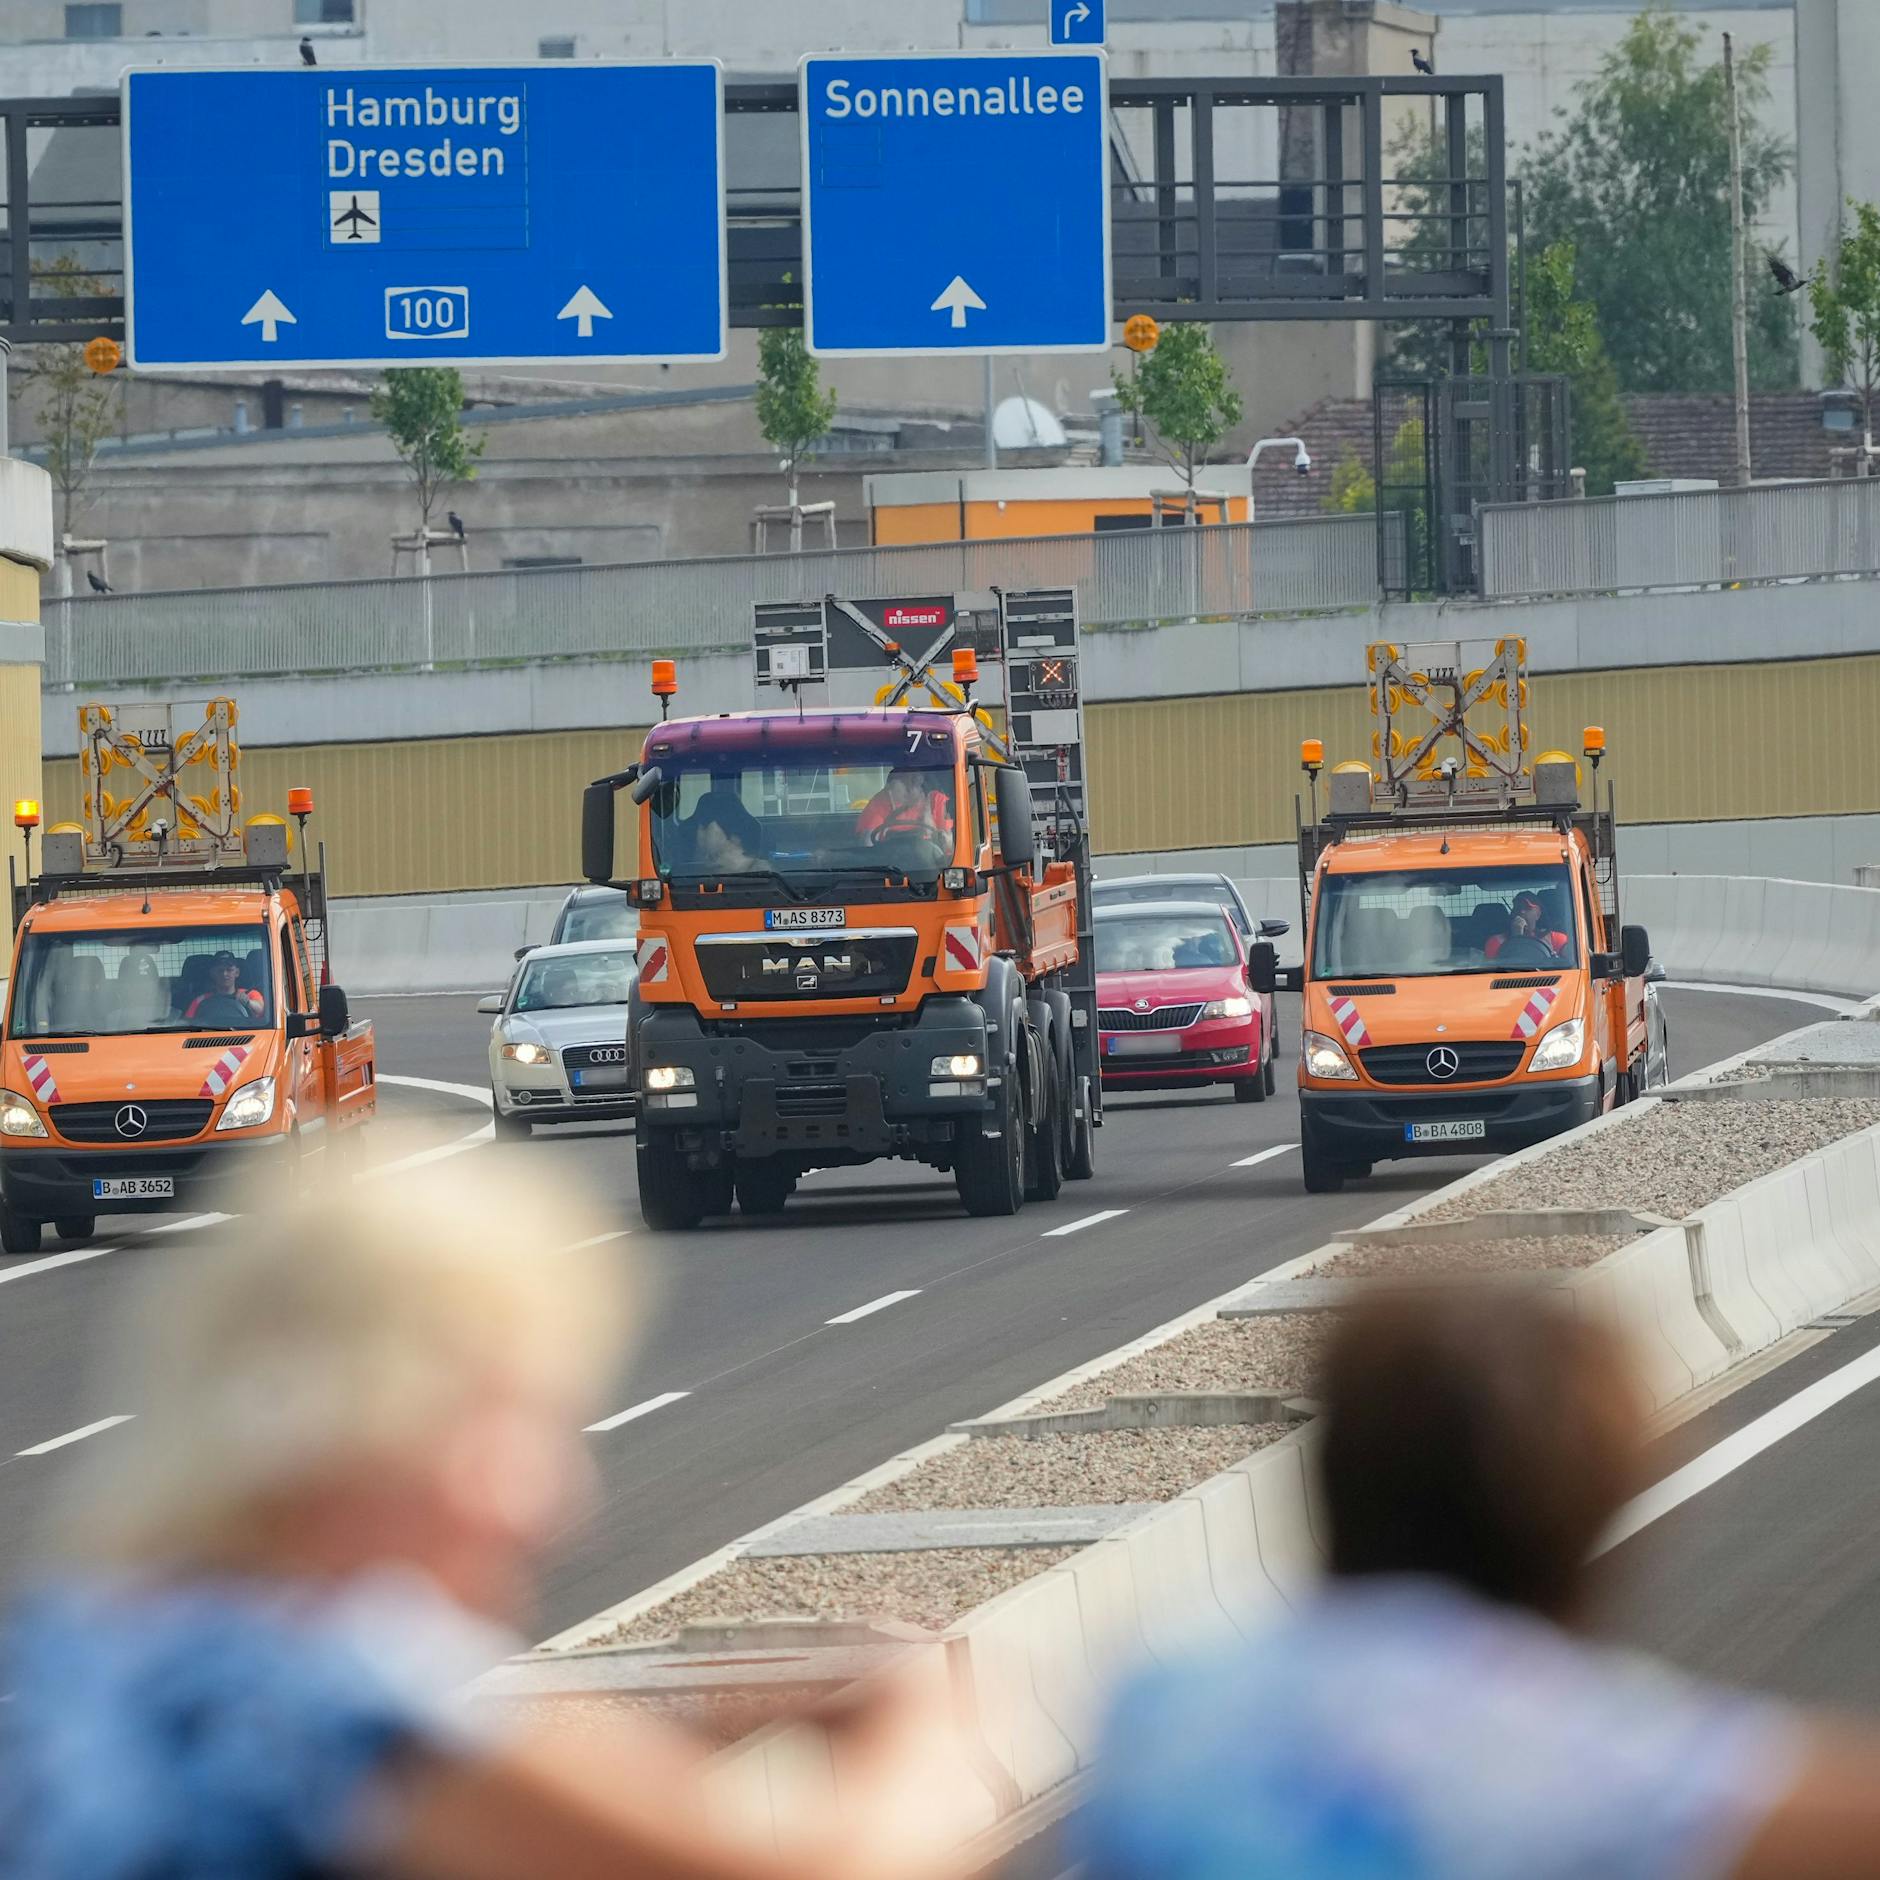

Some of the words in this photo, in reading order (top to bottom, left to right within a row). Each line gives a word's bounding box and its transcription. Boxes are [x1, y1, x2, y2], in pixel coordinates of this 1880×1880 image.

[825, 76, 1084, 118] Sonnenallee
[327, 87, 520, 135] Hamburg
[328, 138, 504, 178] Dresden
[400, 297, 454, 329] 100
[888, 609, 937, 625] nissen
[906, 730, 922, 753] 7
[773, 912, 782, 925] M
[790, 911, 807, 924] AS
[810, 910, 843, 923] 8373
[762, 955, 851, 976] MAN
[1413, 1125, 1422, 1138] B
[1431, 1124, 1447, 1137] BA
[1450, 1122, 1483, 1136] 4808
[102, 1181, 111, 1194] B
[120, 1181, 137, 1194] AB
[139, 1180, 172, 1193] 3652
